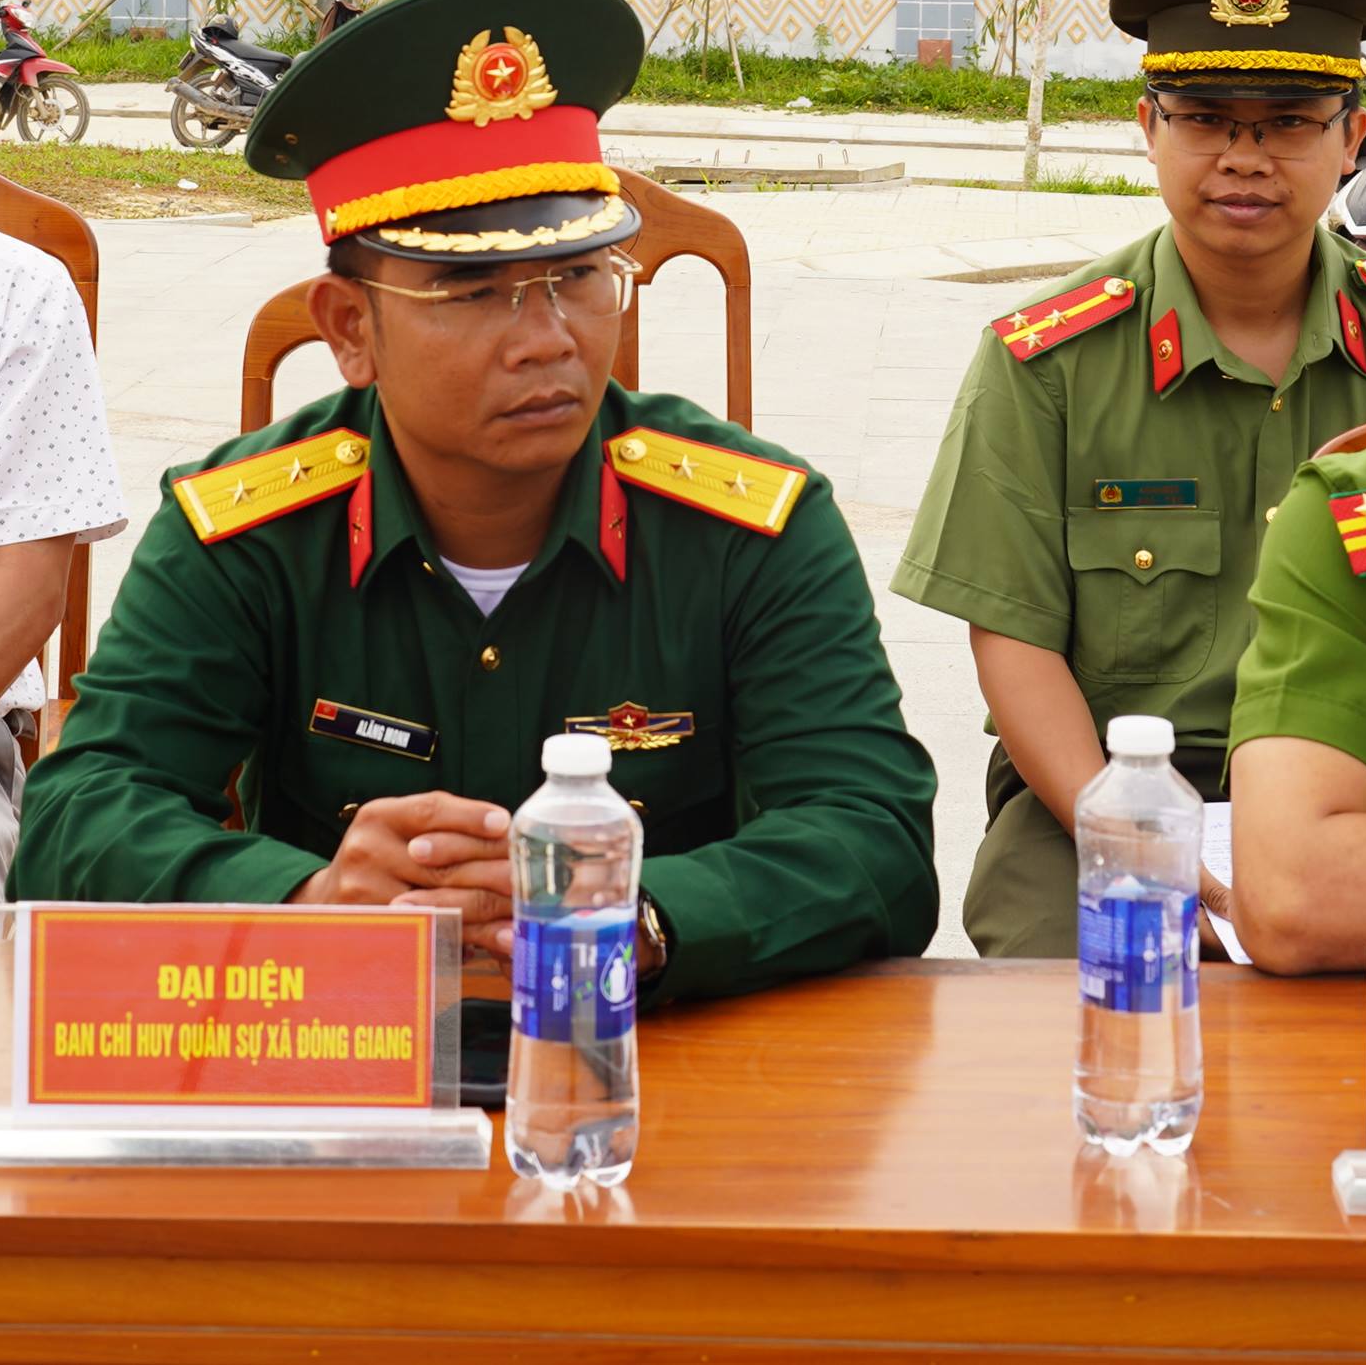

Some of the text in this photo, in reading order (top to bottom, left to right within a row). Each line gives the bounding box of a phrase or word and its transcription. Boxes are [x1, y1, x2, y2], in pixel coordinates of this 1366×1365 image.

[157, 958, 305, 1009] ĐẠI DIỆN
[54, 1011, 413, 1066] BAN CHỈ HUY QUÂN SỰ XÃ ĐÔNG GIANG
